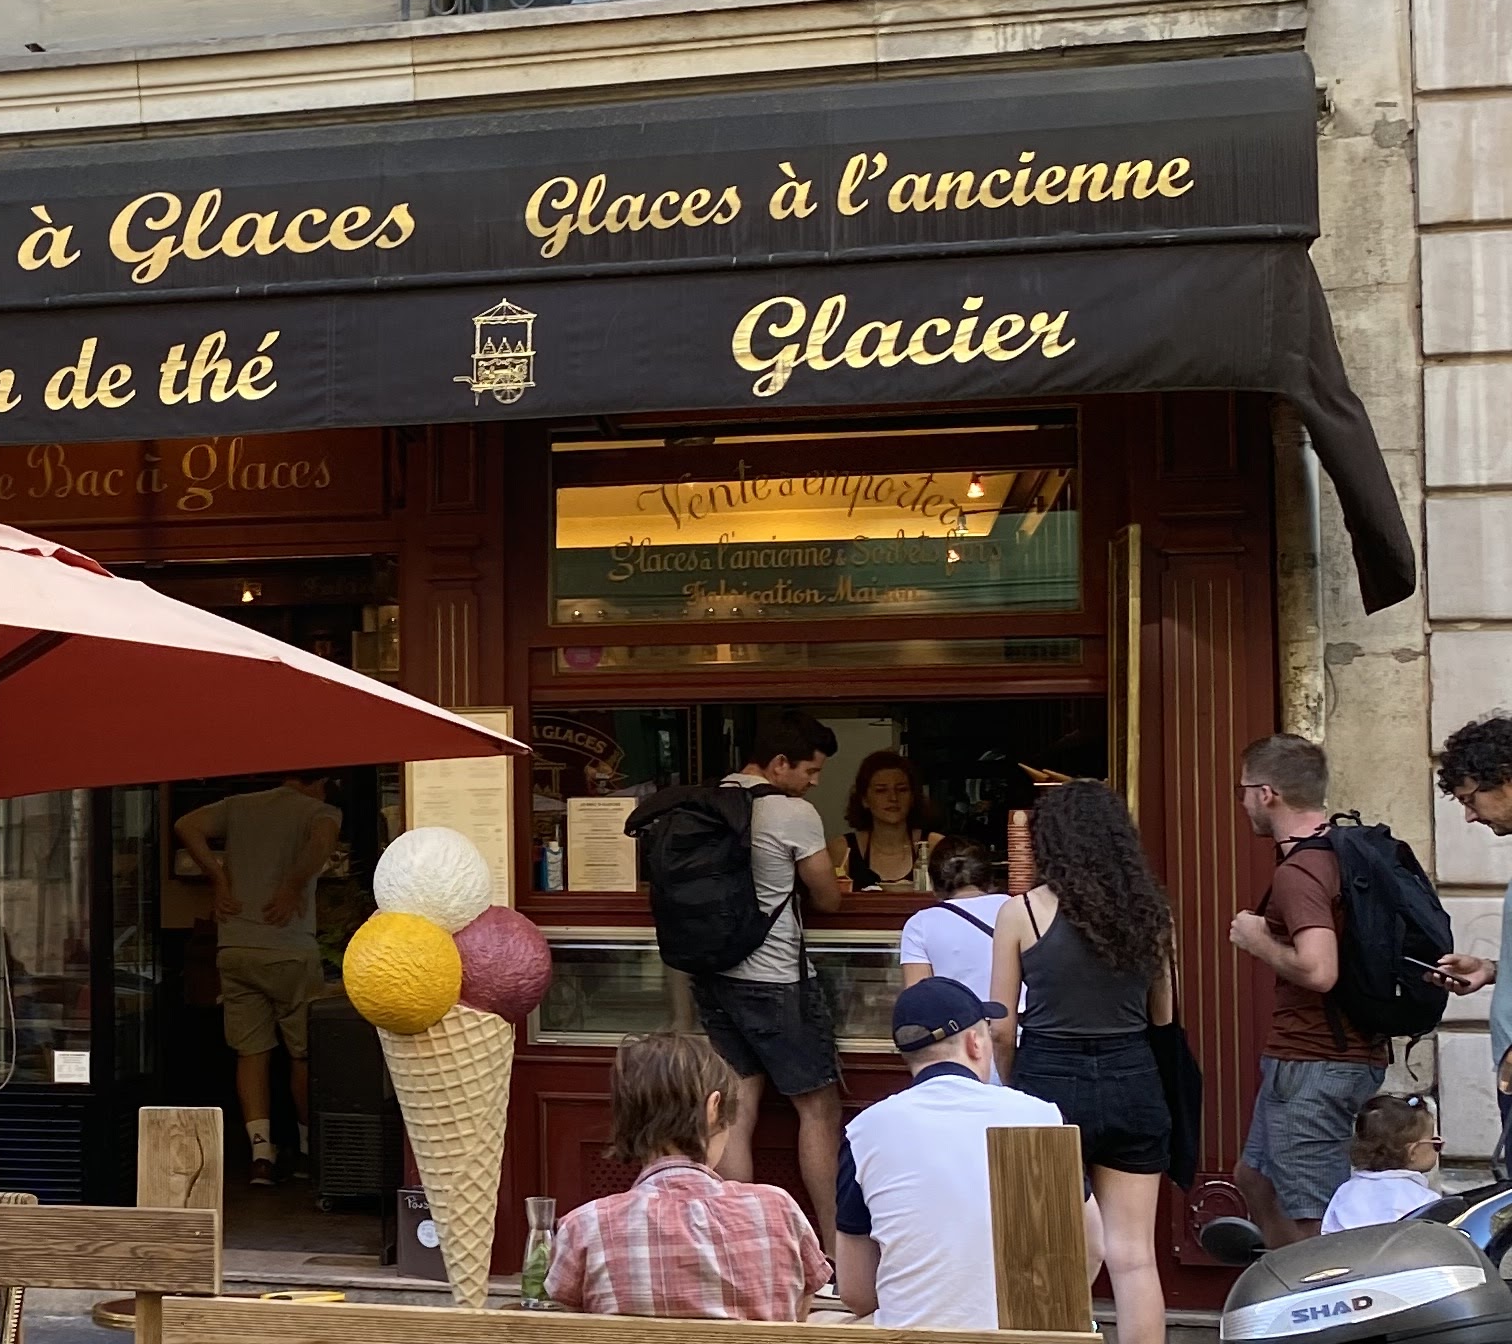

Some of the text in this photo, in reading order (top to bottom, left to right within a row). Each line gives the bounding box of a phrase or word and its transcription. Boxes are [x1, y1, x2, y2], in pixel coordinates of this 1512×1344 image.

[17, 204, 81, 271] à
[108, 187, 416, 285] Glaces
[525, 150, 1195, 259] Glaces à l'ancienne
[44, 336, 136, 411] de
[158, 330, 281, 405] thé
[731, 294, 1076, 397] Glacier
[27, 442, 123, 499] Bac
[136, 454, 168, 494] à
[637, 460, 964, 530] Vente à emporter
[715, 530, 834, 573] l'ancienne
[542, 725, 607, 754] GLACES
[1290, 1295, 1374, 1324] SHAD
